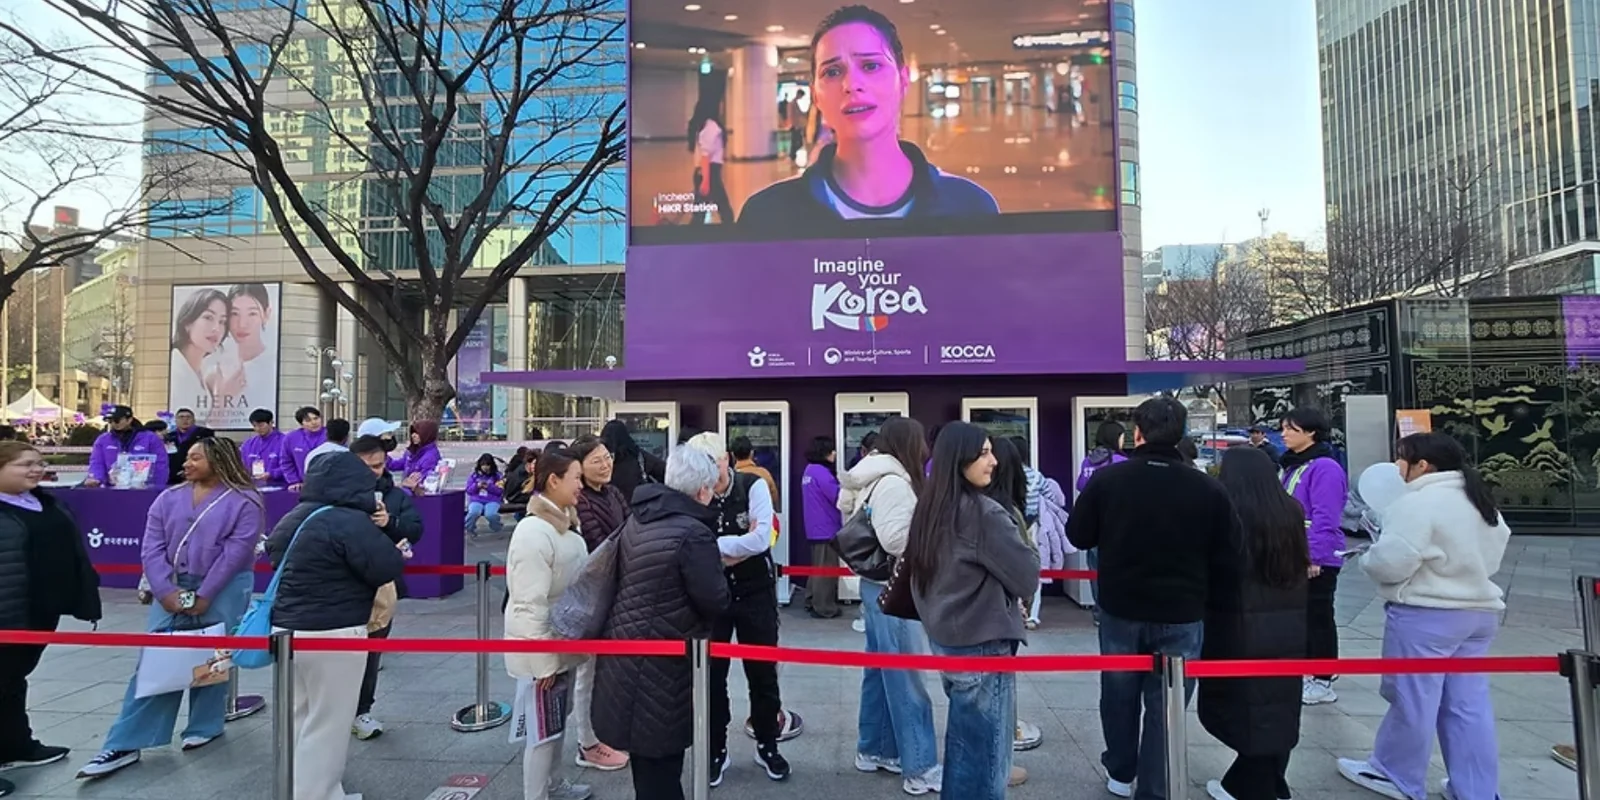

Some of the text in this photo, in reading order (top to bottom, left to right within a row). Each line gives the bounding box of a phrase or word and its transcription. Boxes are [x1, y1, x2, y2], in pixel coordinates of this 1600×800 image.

[658, 192, 695, 201] Incheon
[683, 202, 718, 212] Station
[814, 256, 884, 276] Imagine
[858, 273, 901, 289] your
[812, 281, 928, 331] Korea
[941, 345, 995, 358] KOCCA
[196, 395, 249, 408] HERA
